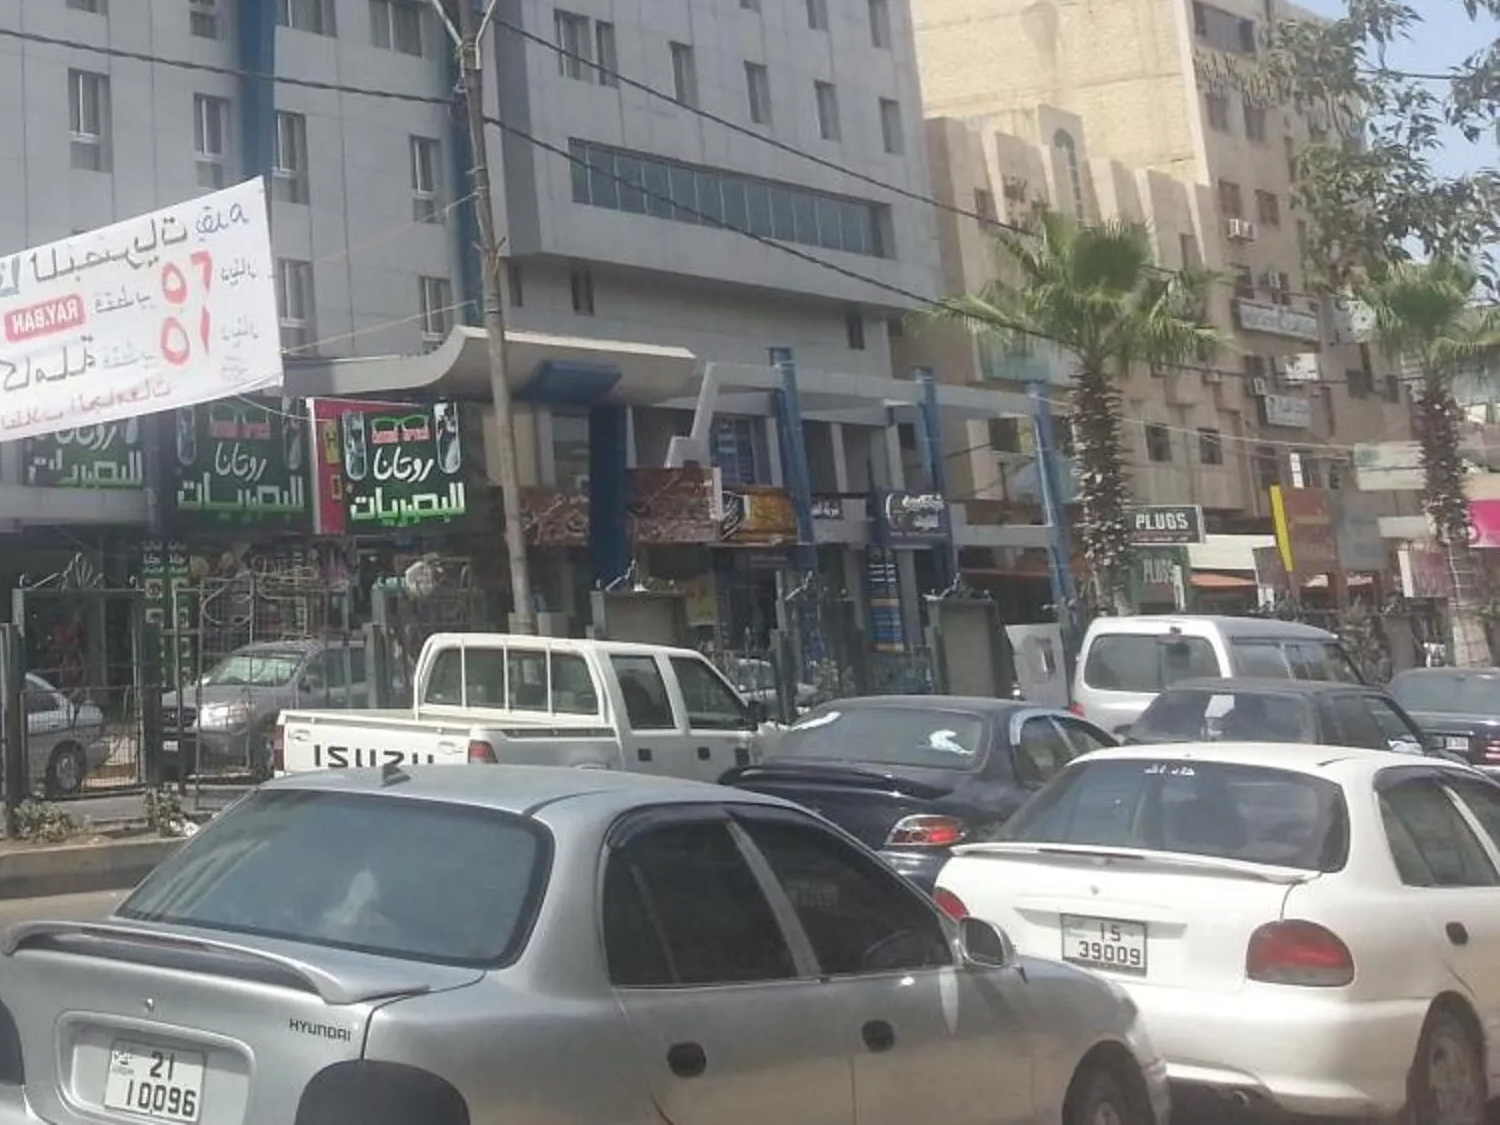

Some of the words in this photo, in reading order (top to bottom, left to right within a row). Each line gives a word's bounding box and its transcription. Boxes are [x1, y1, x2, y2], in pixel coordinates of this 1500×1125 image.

[215, 442, 267, 481] روتانا
[373, 445, 435, 483] روتانا
[1135, 512, 1189, 530] PLUGS
[1100, 922, 1121, 942] 15
[1078, 940, 1141, 966] 39009
[149, 1050, 175, 1082] 21
[126, 1079, 197, 1118] 10096
